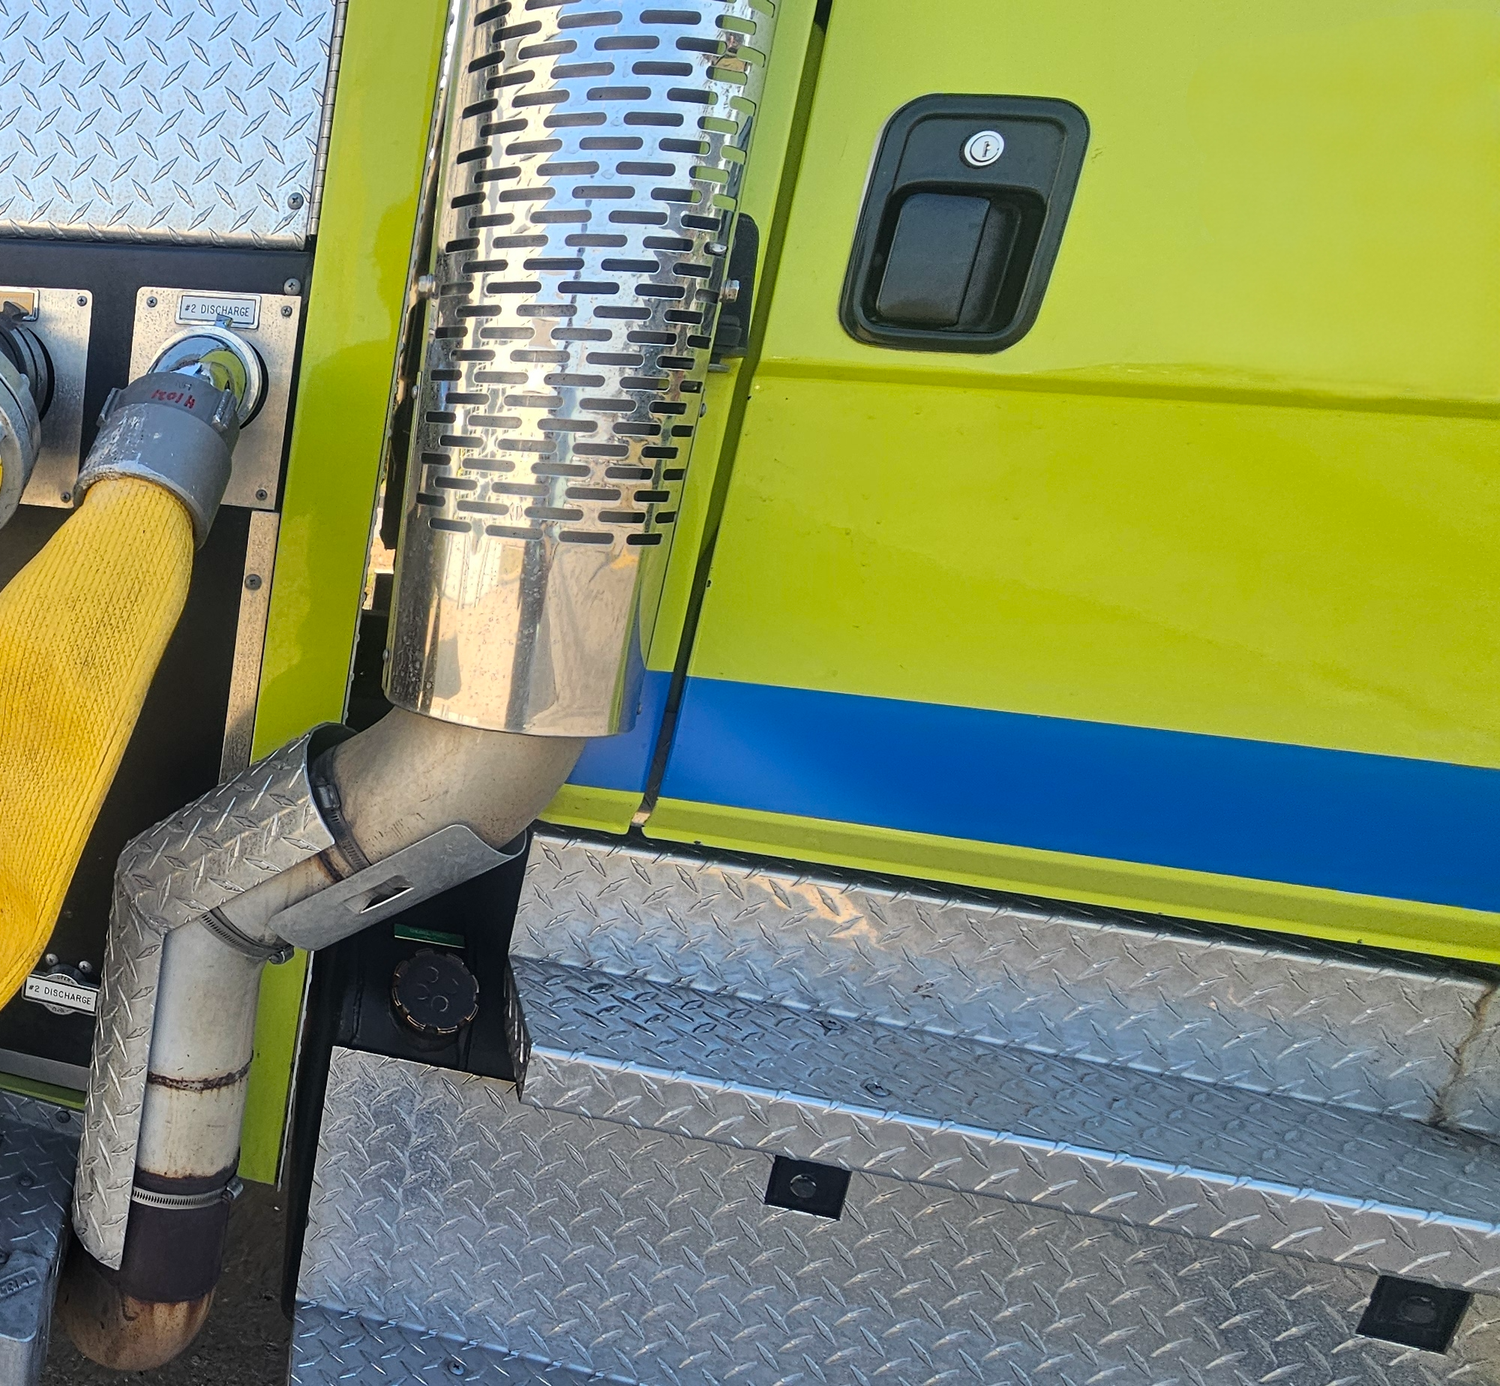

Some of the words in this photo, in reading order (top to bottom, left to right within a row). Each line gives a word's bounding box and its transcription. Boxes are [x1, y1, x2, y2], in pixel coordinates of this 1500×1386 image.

[185, 303, 197, 314] #2
[200, 304, 251, 317] DISCHARGE
[29, 984, 40, 993] #2
[44, 986, 92, 1005] DISCHARGE
